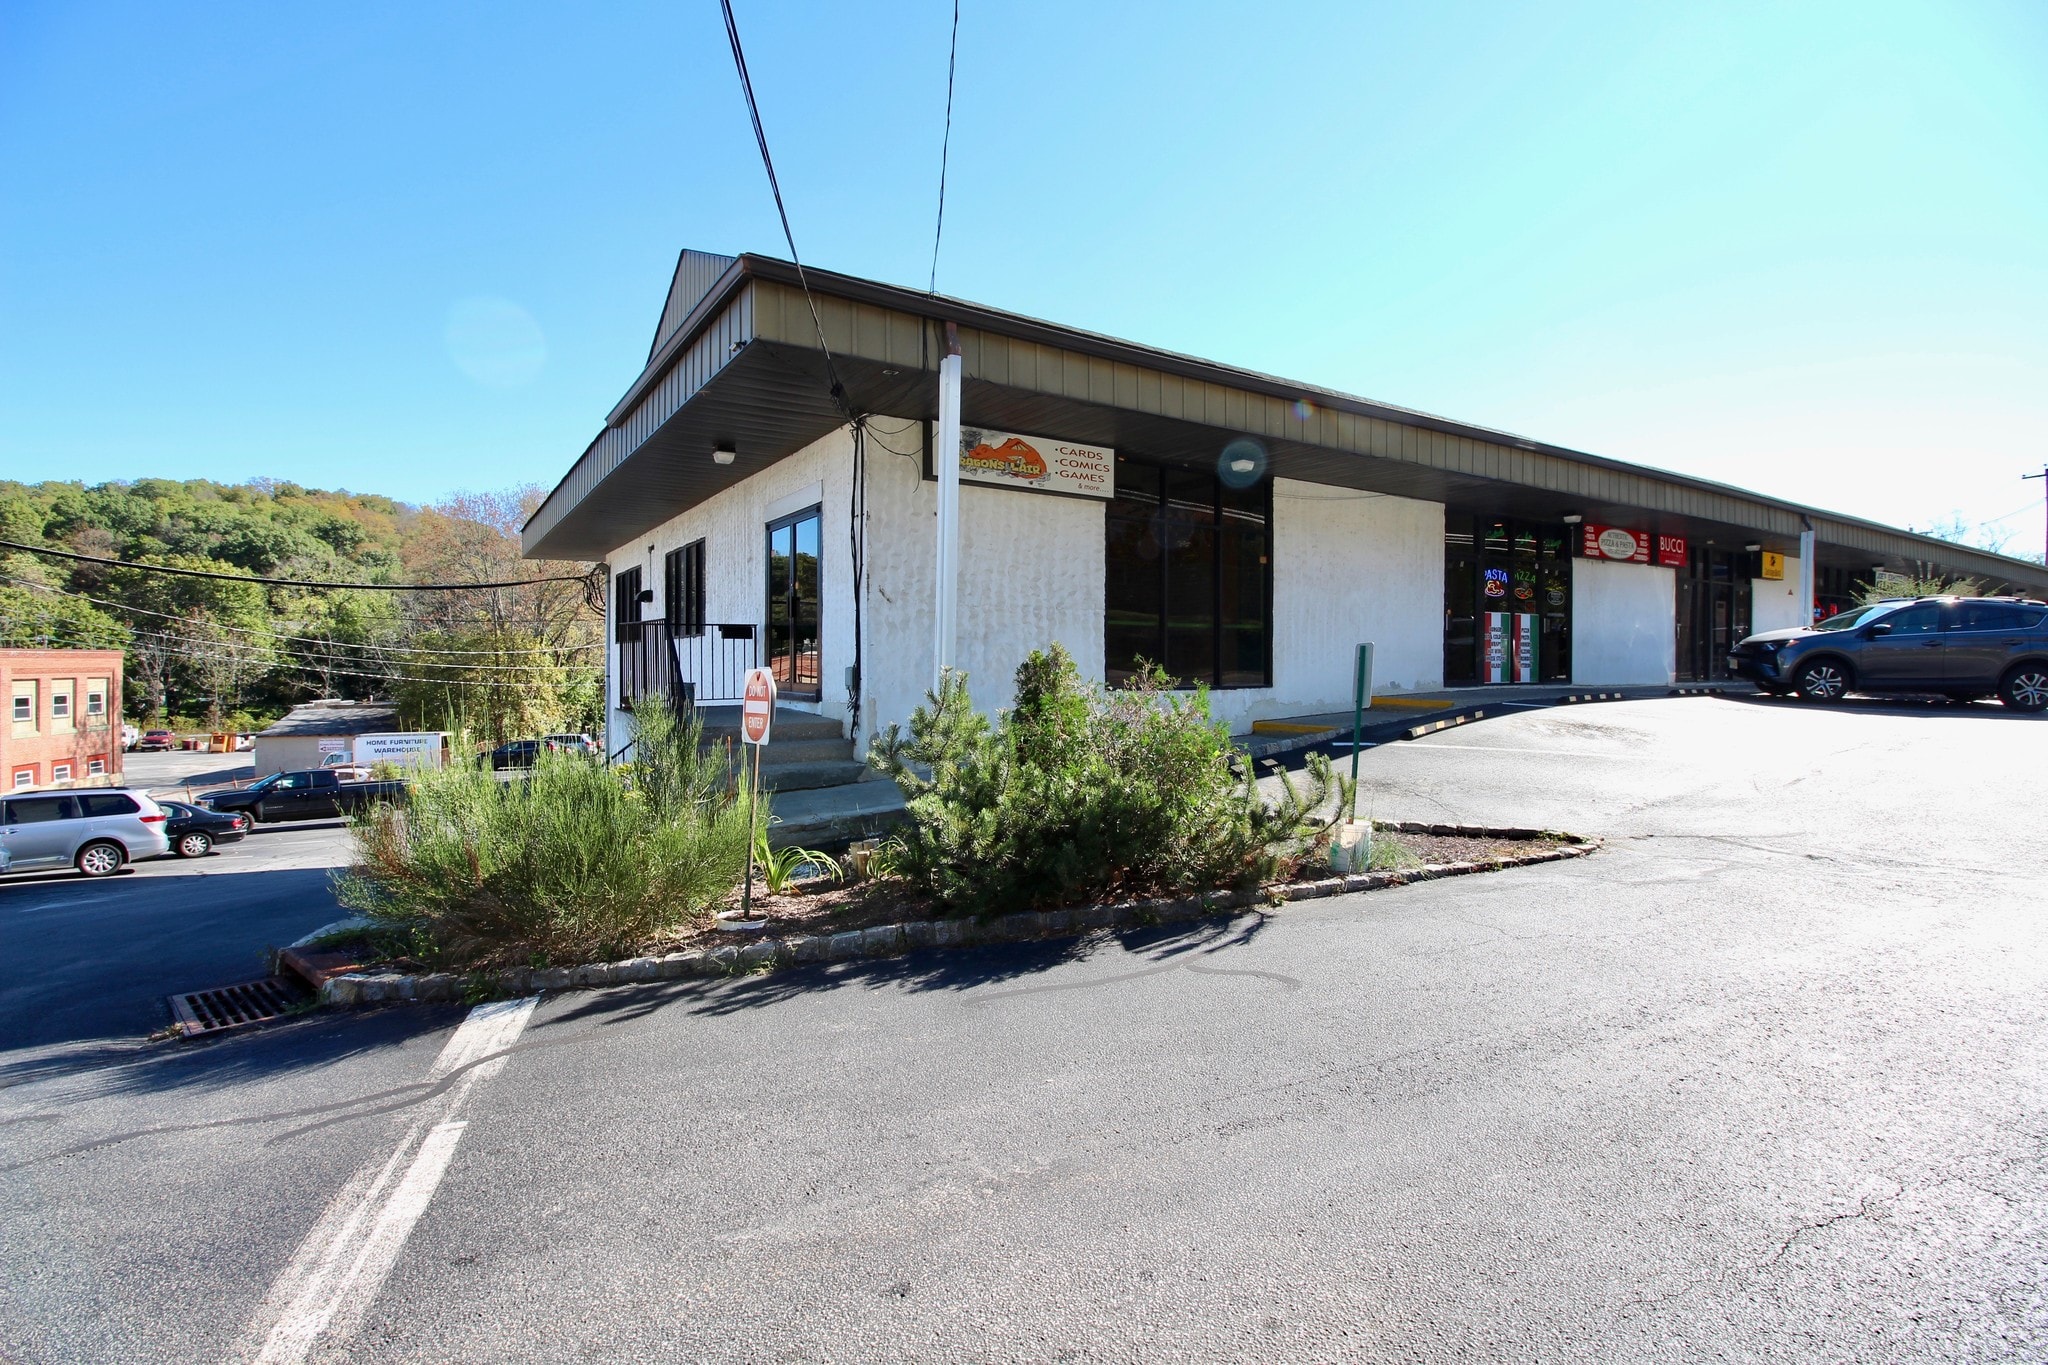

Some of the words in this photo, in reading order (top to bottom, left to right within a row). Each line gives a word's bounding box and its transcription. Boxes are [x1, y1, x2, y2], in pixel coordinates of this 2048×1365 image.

[1059, 446, 1103, 461] CARDS
[1010, 460, 1041, 475] LAIR
[1059, 458, 1110, 473] COMICS
[1059, 470, 1105, 483] GAMES
[1600, 538, 1615, 548] PIZZA
[1660, 536, 1684, 554] BUCCI
[1514, 570, 1536, 584] IZZA
[748, 685, 756, 697] DO
[757, 685, 767, 697] NOT
[748, 716, 764, 729] ENTER
[389, 738, 428, 746] FURNITURE
[374, 746, 421, 754] WAREHOUSE
